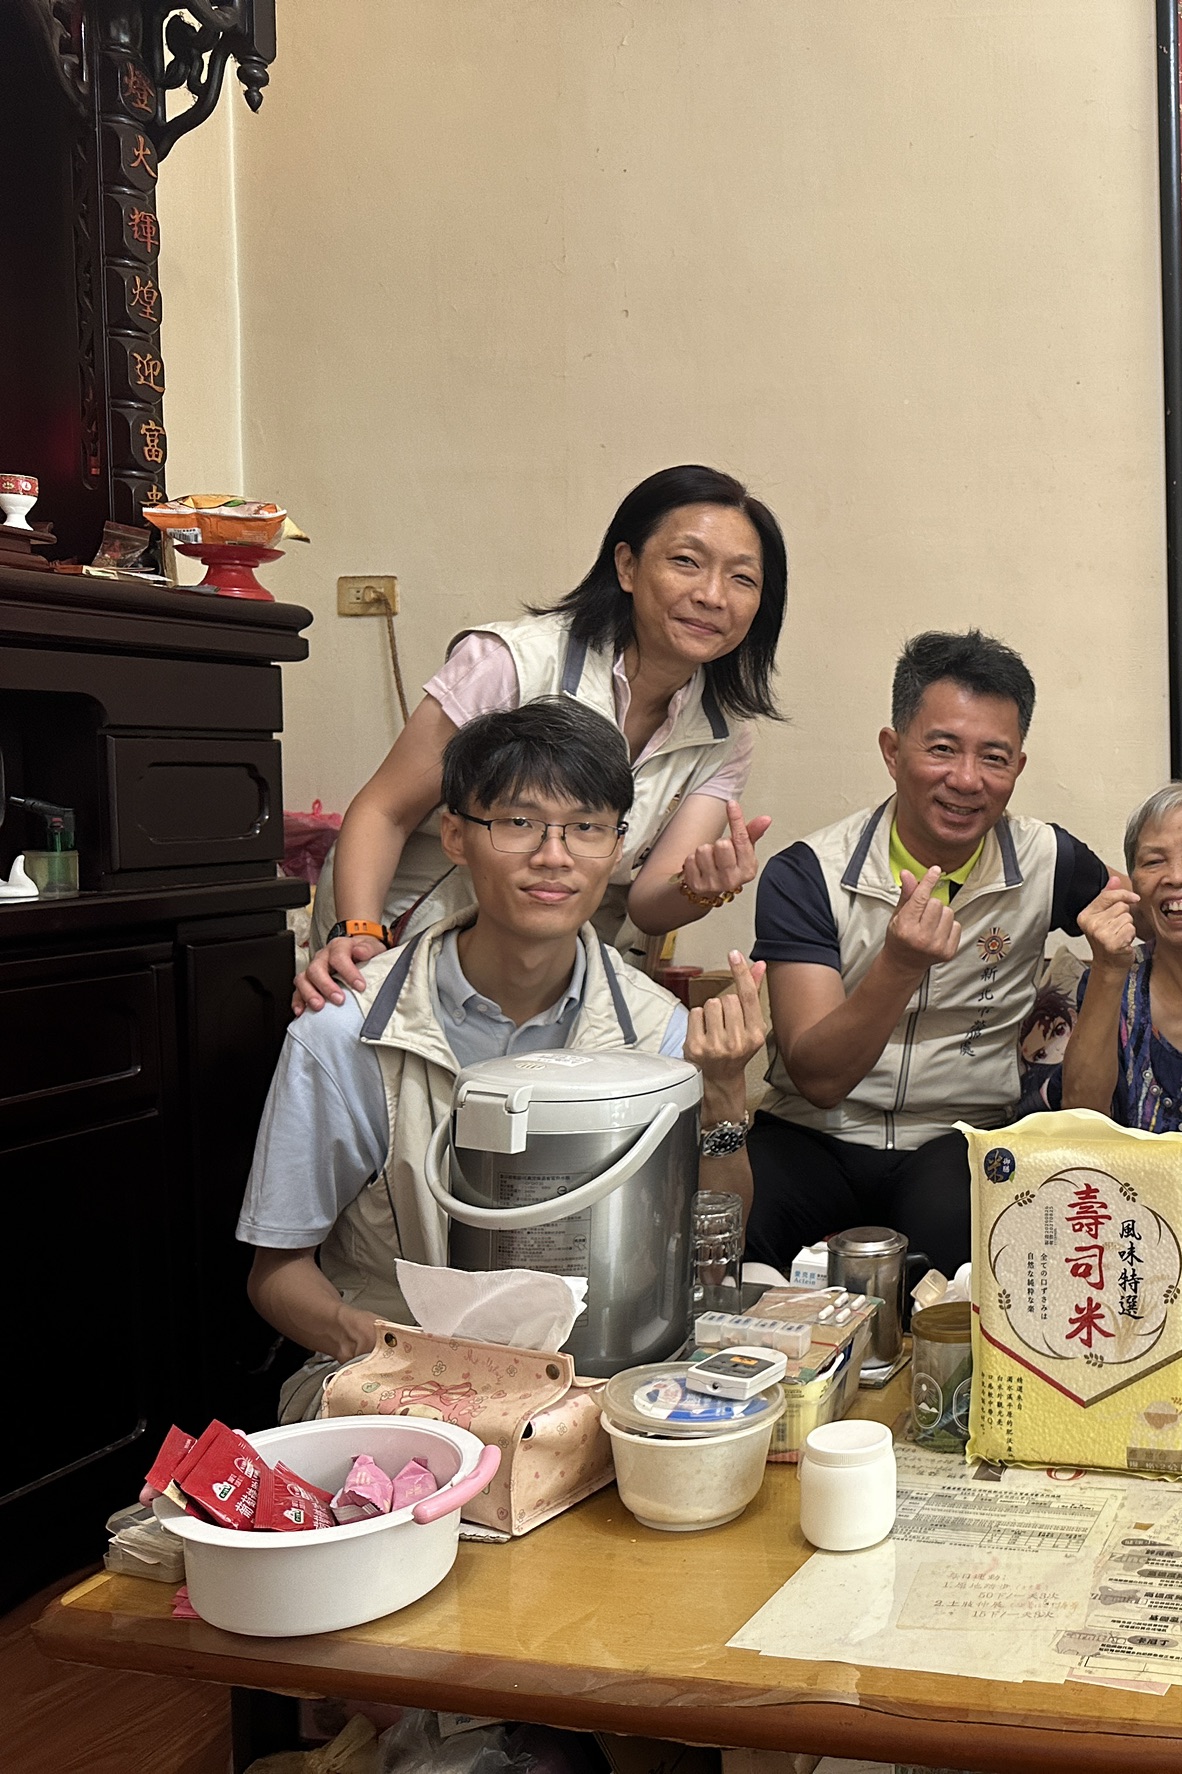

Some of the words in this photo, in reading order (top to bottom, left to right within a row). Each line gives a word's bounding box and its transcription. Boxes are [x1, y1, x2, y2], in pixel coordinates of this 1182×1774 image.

[1064, 1182, 1116, 1348] 壽司米
[1117, 1218, 1145, 1320] 風味特選
